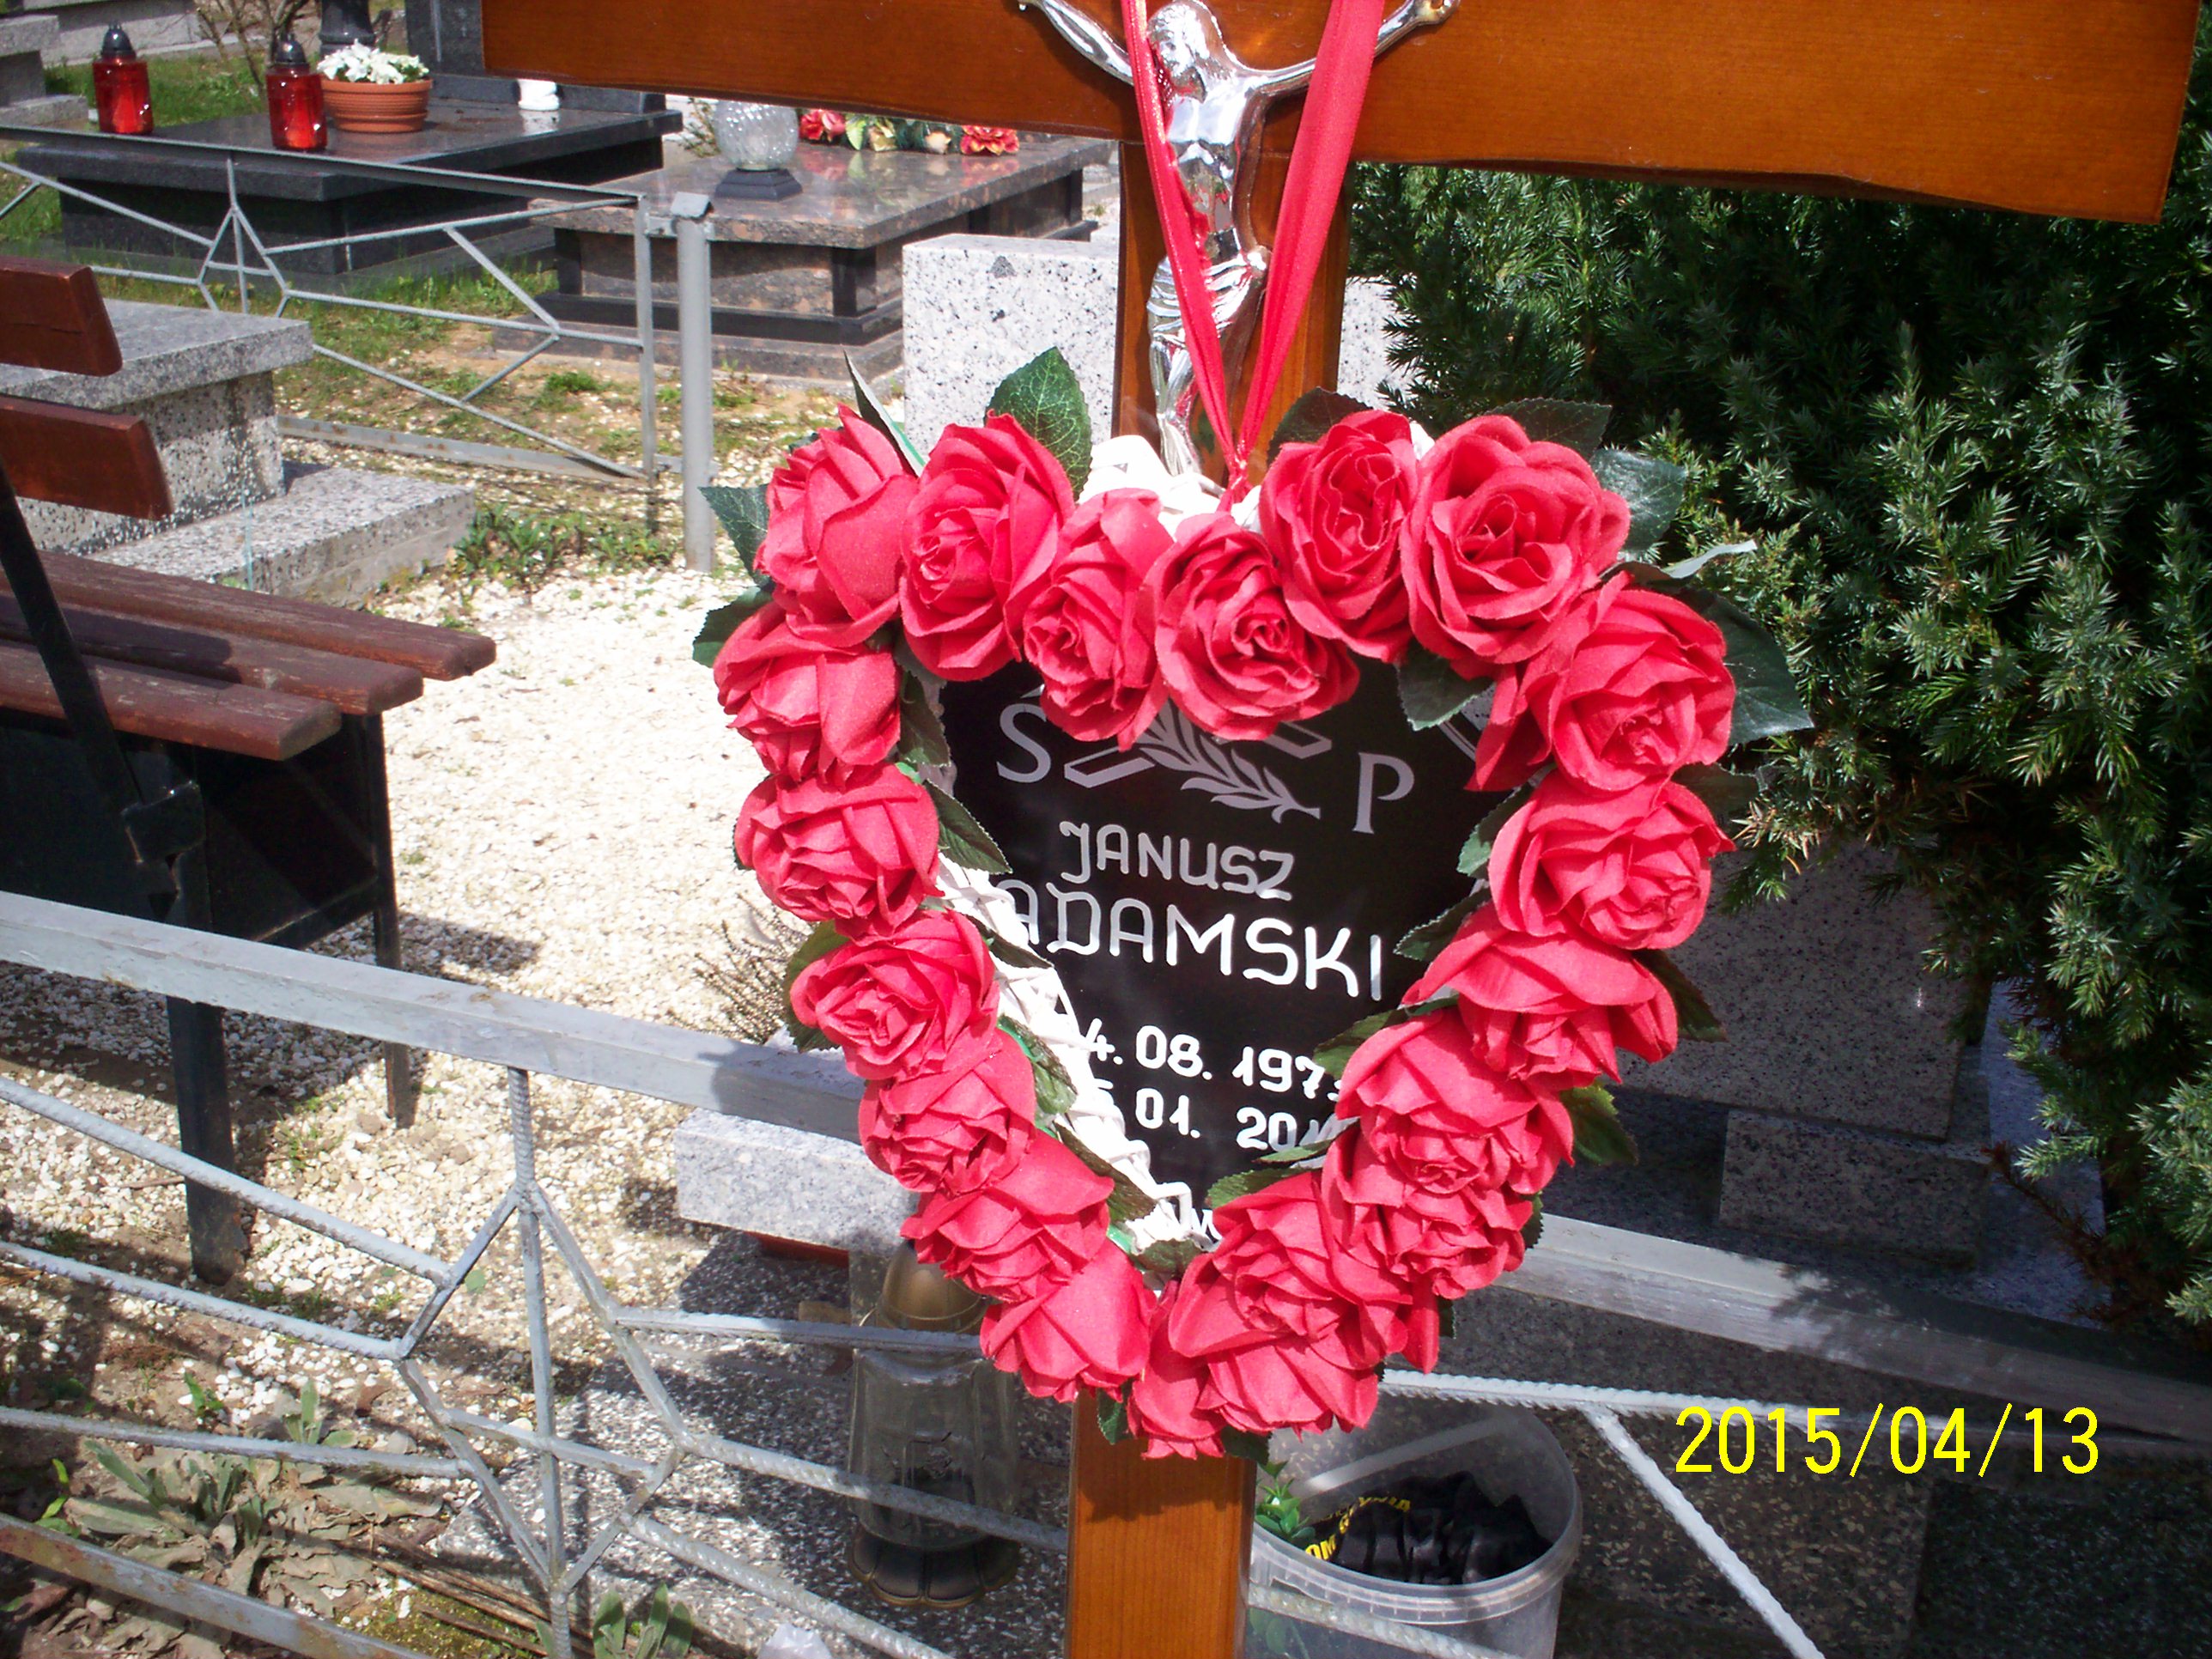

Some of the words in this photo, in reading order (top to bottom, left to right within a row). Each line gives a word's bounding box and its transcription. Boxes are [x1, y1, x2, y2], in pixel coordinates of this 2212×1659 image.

[1353, 752, 1415, 834] P
[1060, 821, 1294, 901] JANUSZ
[1135, 1024, 1212, 1080] 08.
[1232, 1046, 1341, 1102] 197
[1135, 1087, 1200, 1139] 01.
